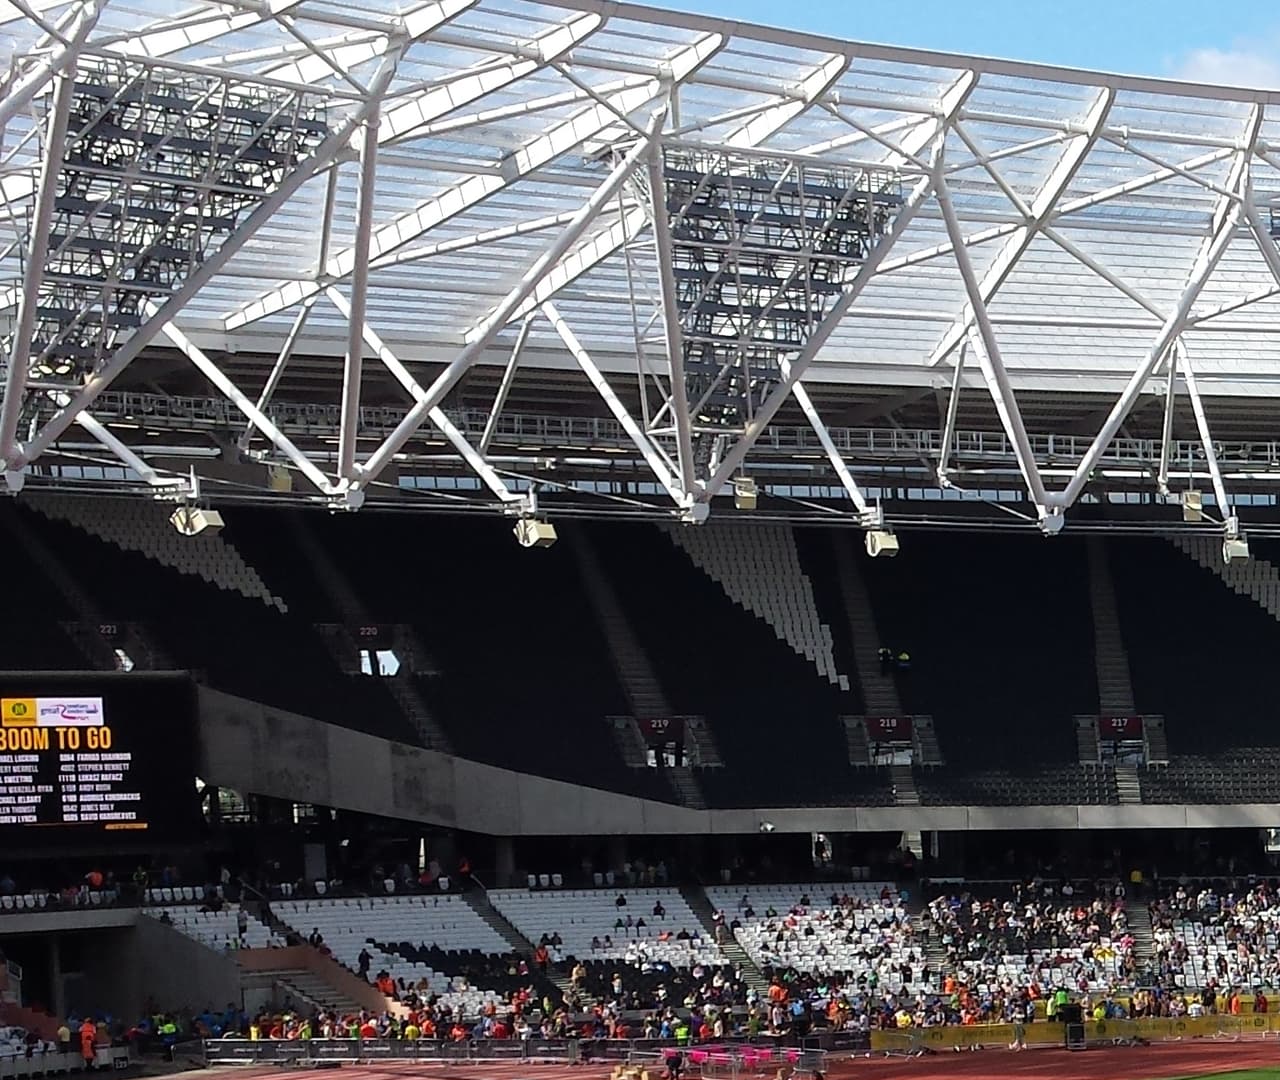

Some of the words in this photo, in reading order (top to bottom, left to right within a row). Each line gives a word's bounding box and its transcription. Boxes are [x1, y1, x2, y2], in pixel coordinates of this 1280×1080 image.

[650, 719, 668, 728] 219
[1111, 718, 1128, 727] 217
[55, 728, 80, 750] TO
[87, 727, 112, 749] GO
